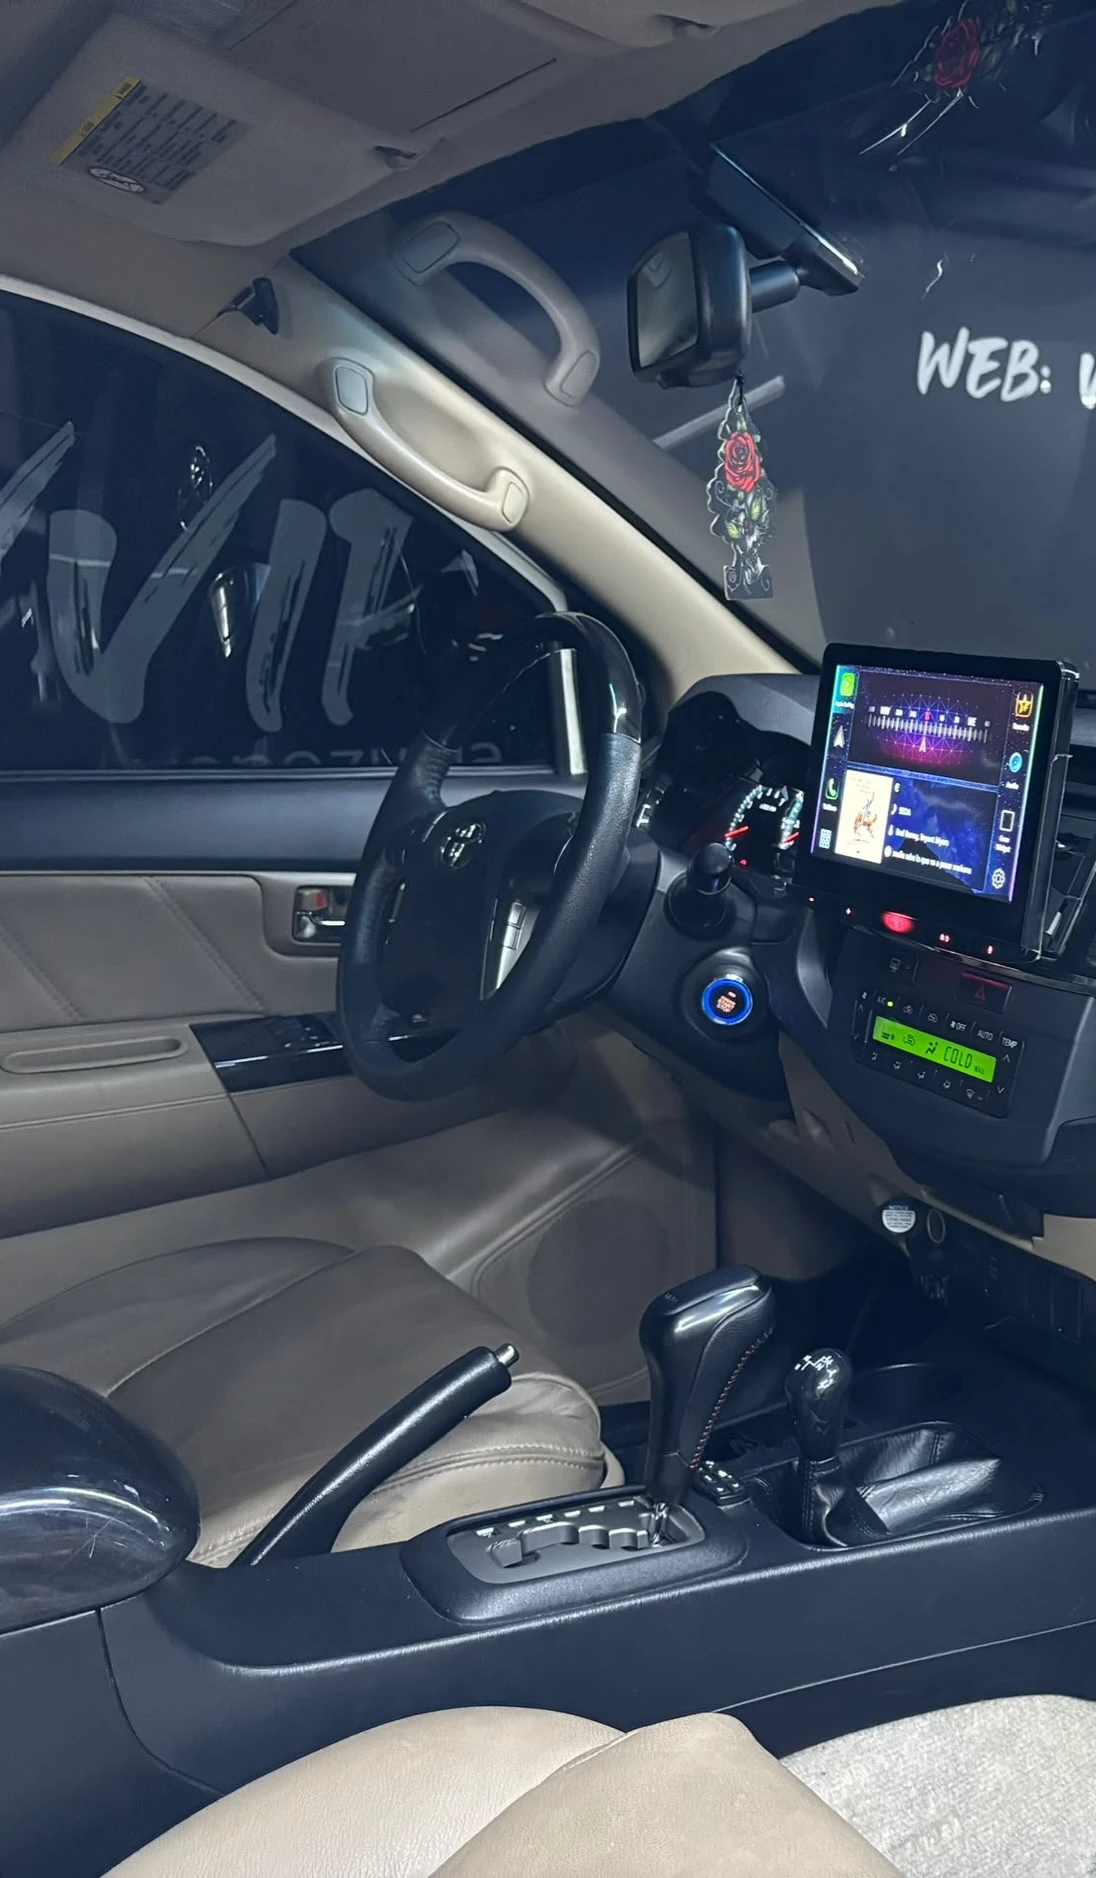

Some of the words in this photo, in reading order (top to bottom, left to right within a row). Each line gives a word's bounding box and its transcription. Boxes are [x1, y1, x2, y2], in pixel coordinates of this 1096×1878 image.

[917, 327, 1052, 402] WEB:
[956, 1022, 967, 1031] OFF
[977, 1030, 994, 1041] AUTO
[1002, 1037, 1018, 1048] TEMP
[944, 1046, 973, 1069] COLD
